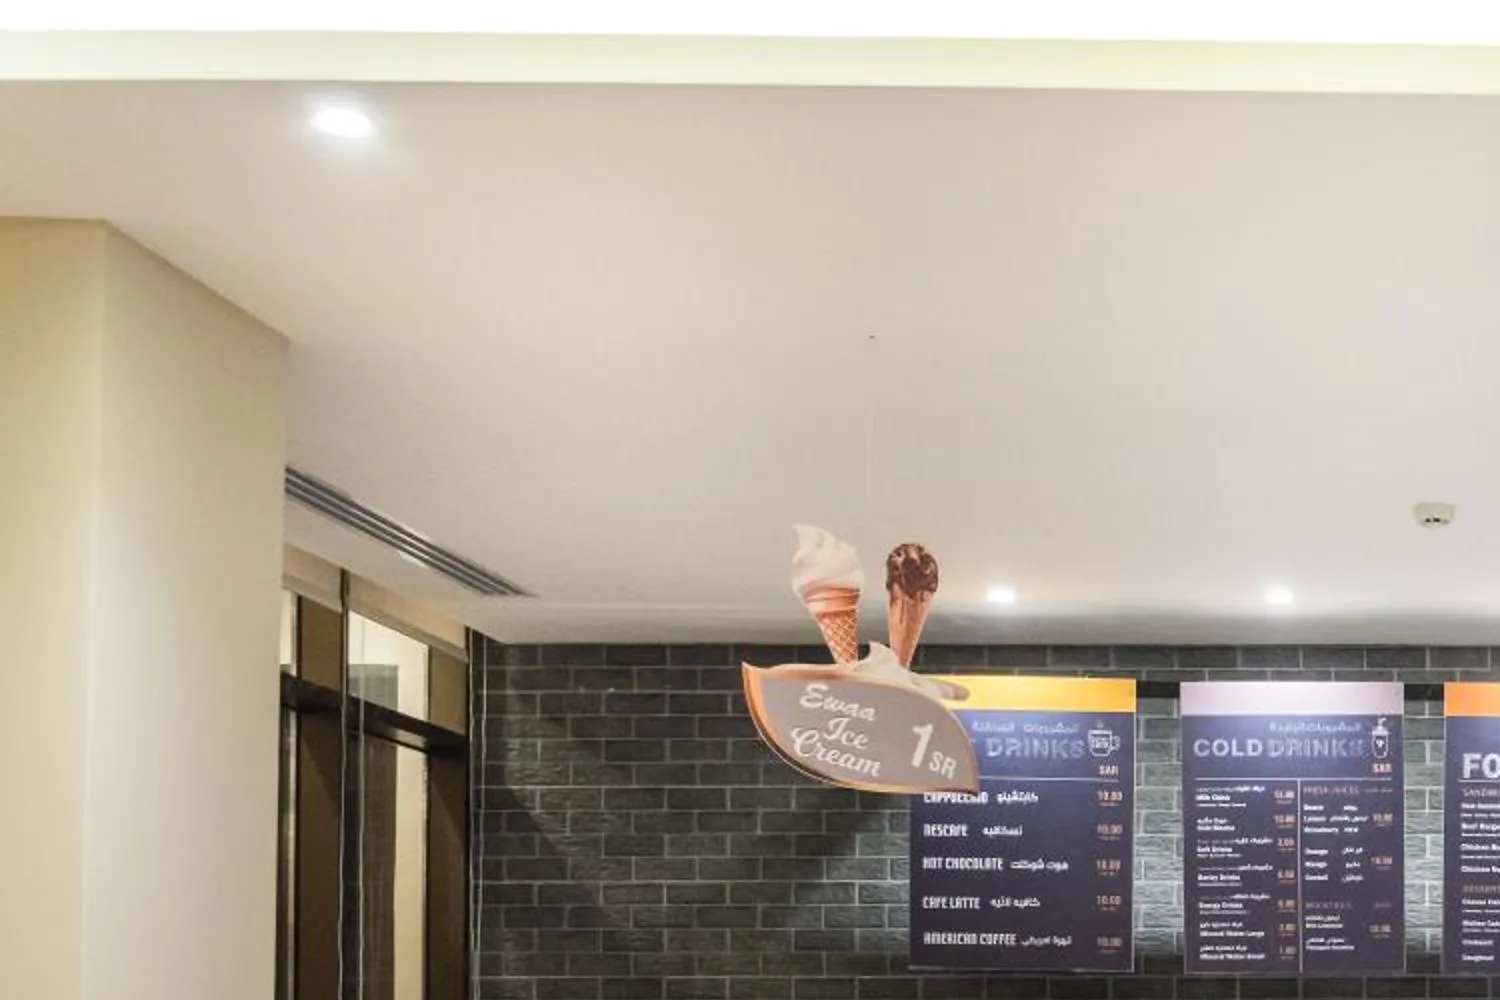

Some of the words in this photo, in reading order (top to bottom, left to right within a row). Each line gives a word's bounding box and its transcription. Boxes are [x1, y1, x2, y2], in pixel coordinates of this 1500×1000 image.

[800, 683, 876, 721] Ewaa
[823, 717, 868, 750] Ice
[790, 727, 881, 777] Cream
[912, 723, 934, 768] 1
[929, 751, 958, 779] SR
[986, 737, 1086, 759] DRINKS
[1193, 738, 1263, 757] COLD
[1267, 738, 1365, 758] DRINKS
[923, 823, 969, 836] NESCAFE
[945, 857, 1003, 872] CHOCOLATE
[922, 896, 948, 909] CAFE
[949, 896, 981, 910] LATTE
[923, 932, 977, 945] AMERICAN
[980, 932, 1017, 945] COFFEE
